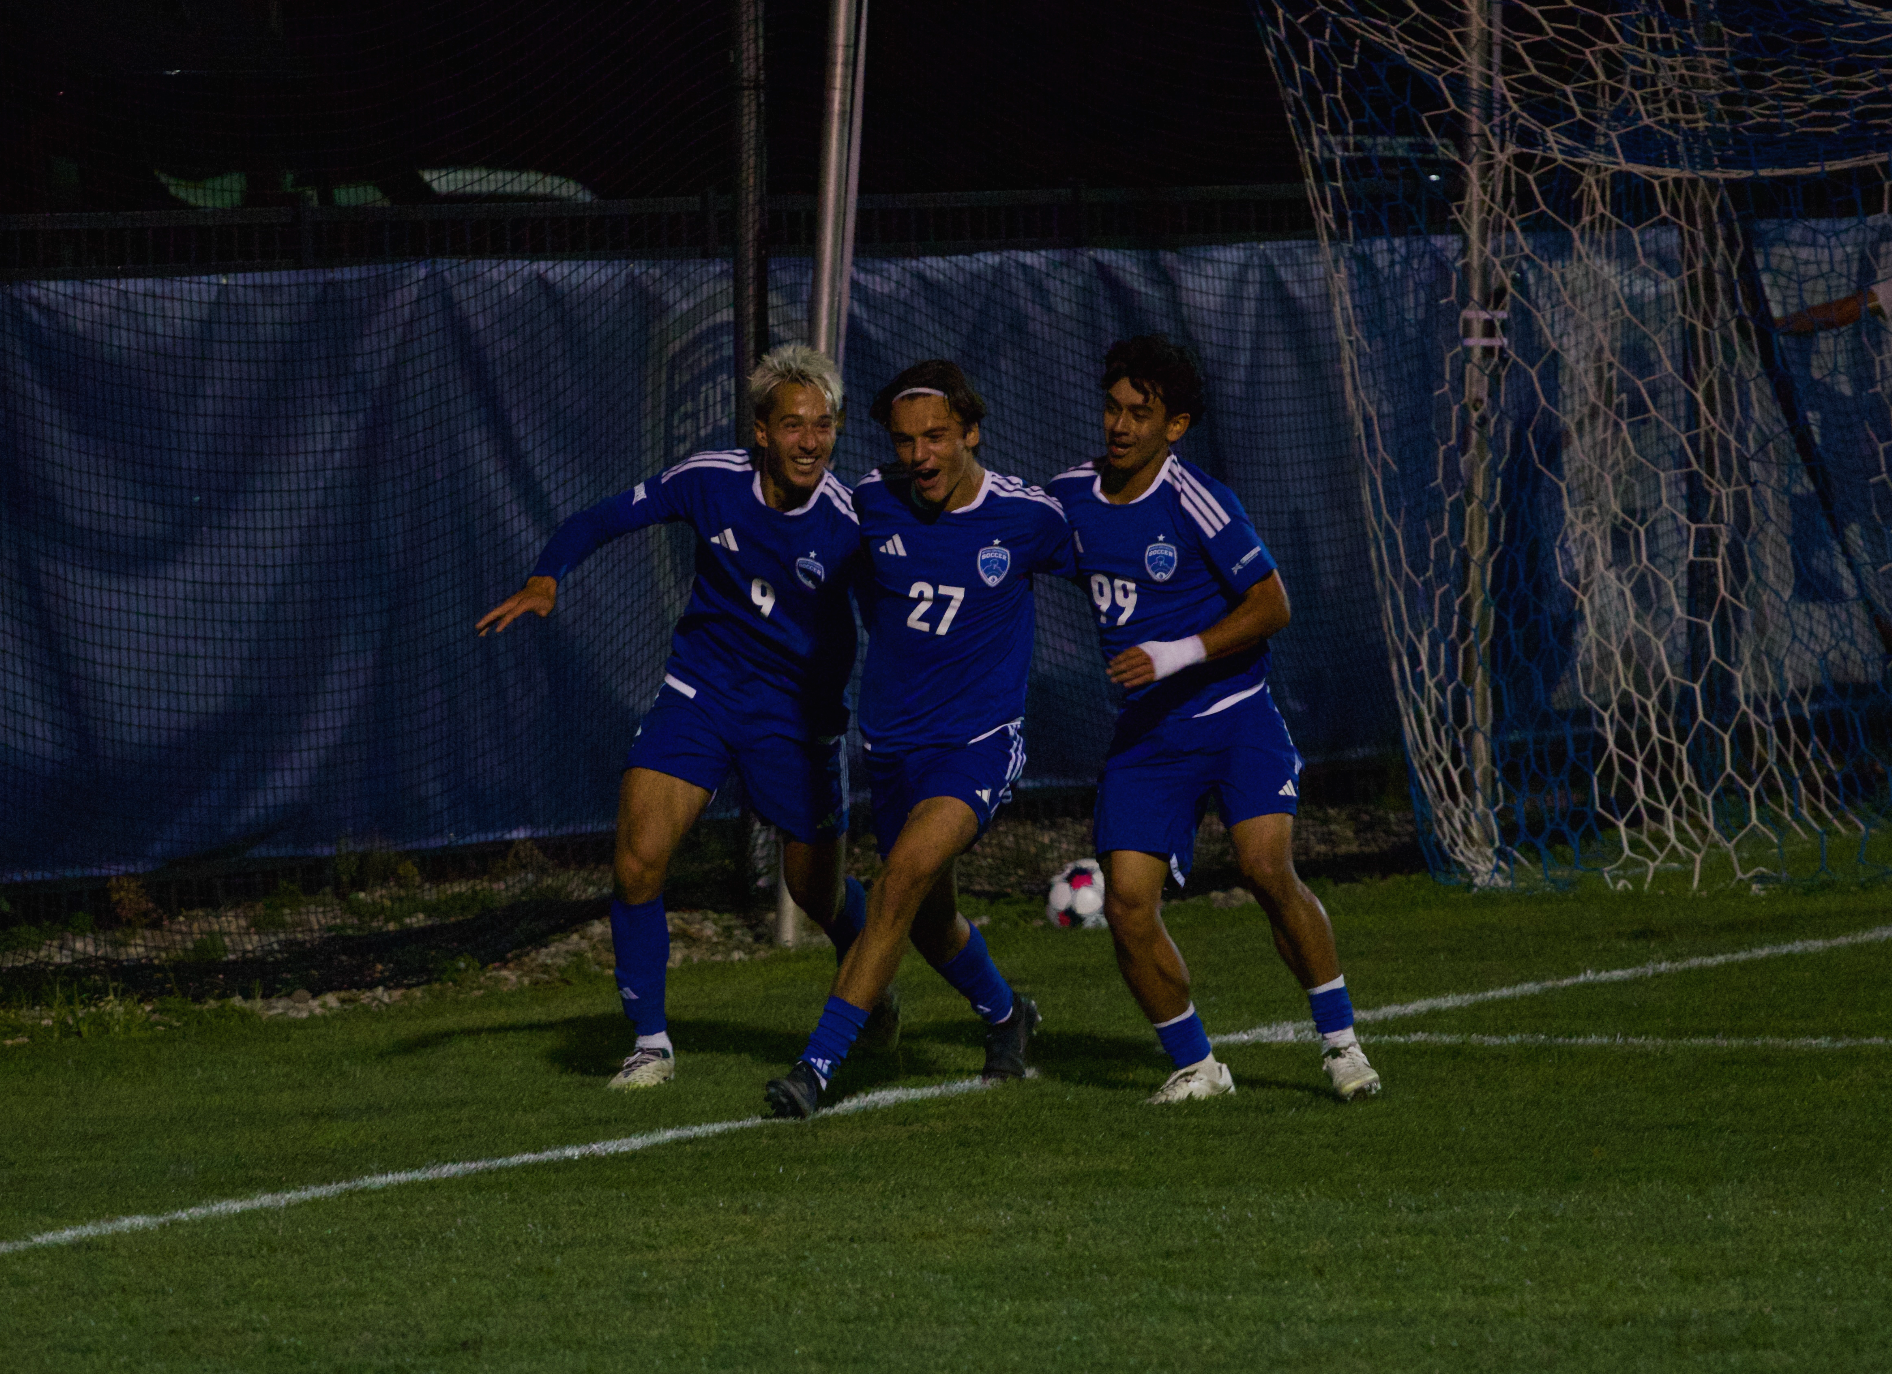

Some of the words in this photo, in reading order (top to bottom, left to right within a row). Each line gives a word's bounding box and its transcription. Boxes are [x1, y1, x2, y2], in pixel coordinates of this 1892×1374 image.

[981, 552, 1007, 562] SOCCER
[1148, 549, 1174, 558] SOCCER
[750, 577, 776, 618] 9
[906, 581, 966, 636] 27
[1090, 573, 1138, 626] 99
